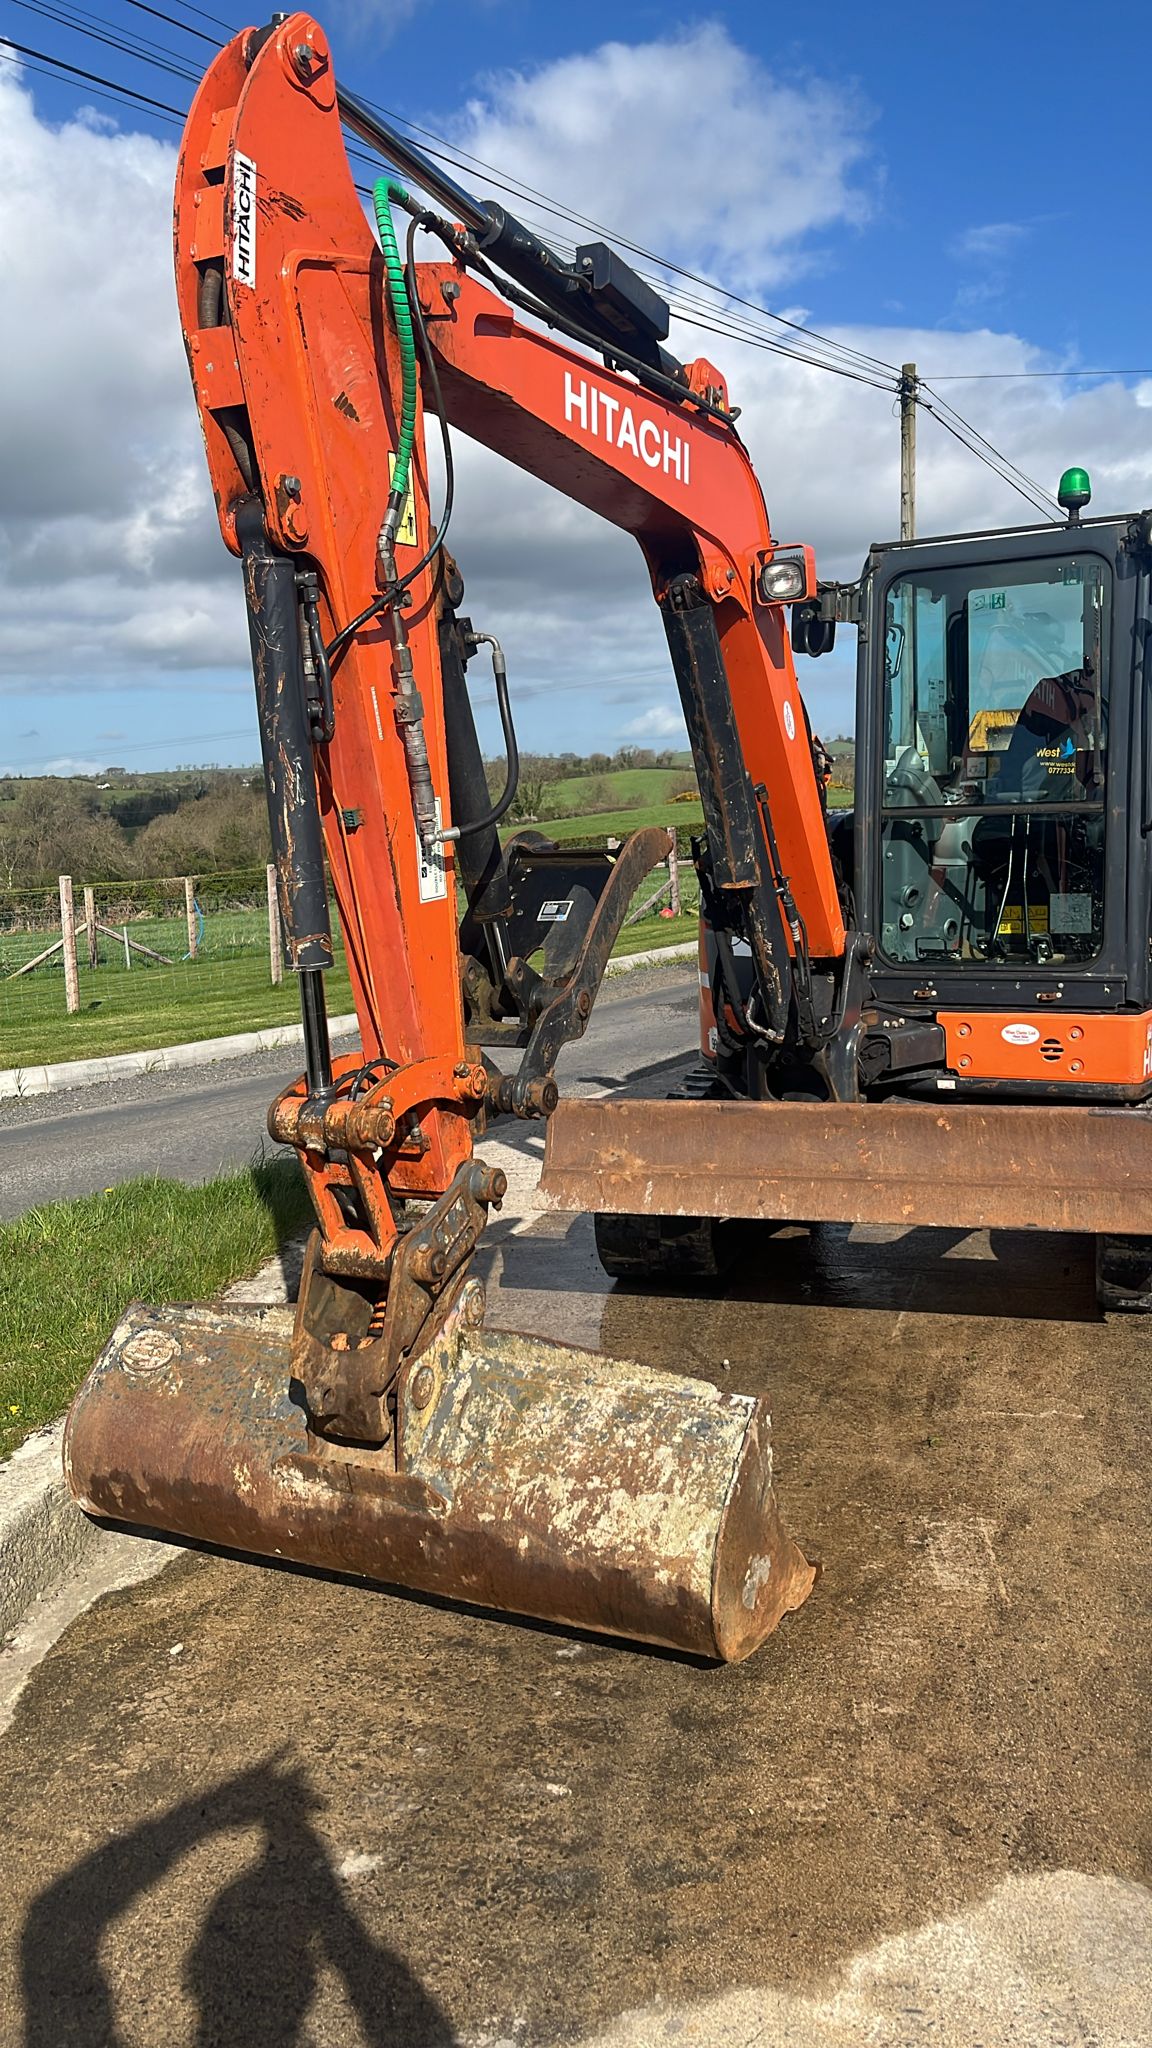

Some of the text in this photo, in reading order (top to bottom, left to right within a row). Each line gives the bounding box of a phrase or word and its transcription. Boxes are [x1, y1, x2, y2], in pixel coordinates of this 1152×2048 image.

[237, 160, 252, 277] HITACHI
[564, 370, 690, 485] HITACHI
[1036, 747, 1060, 758] West
